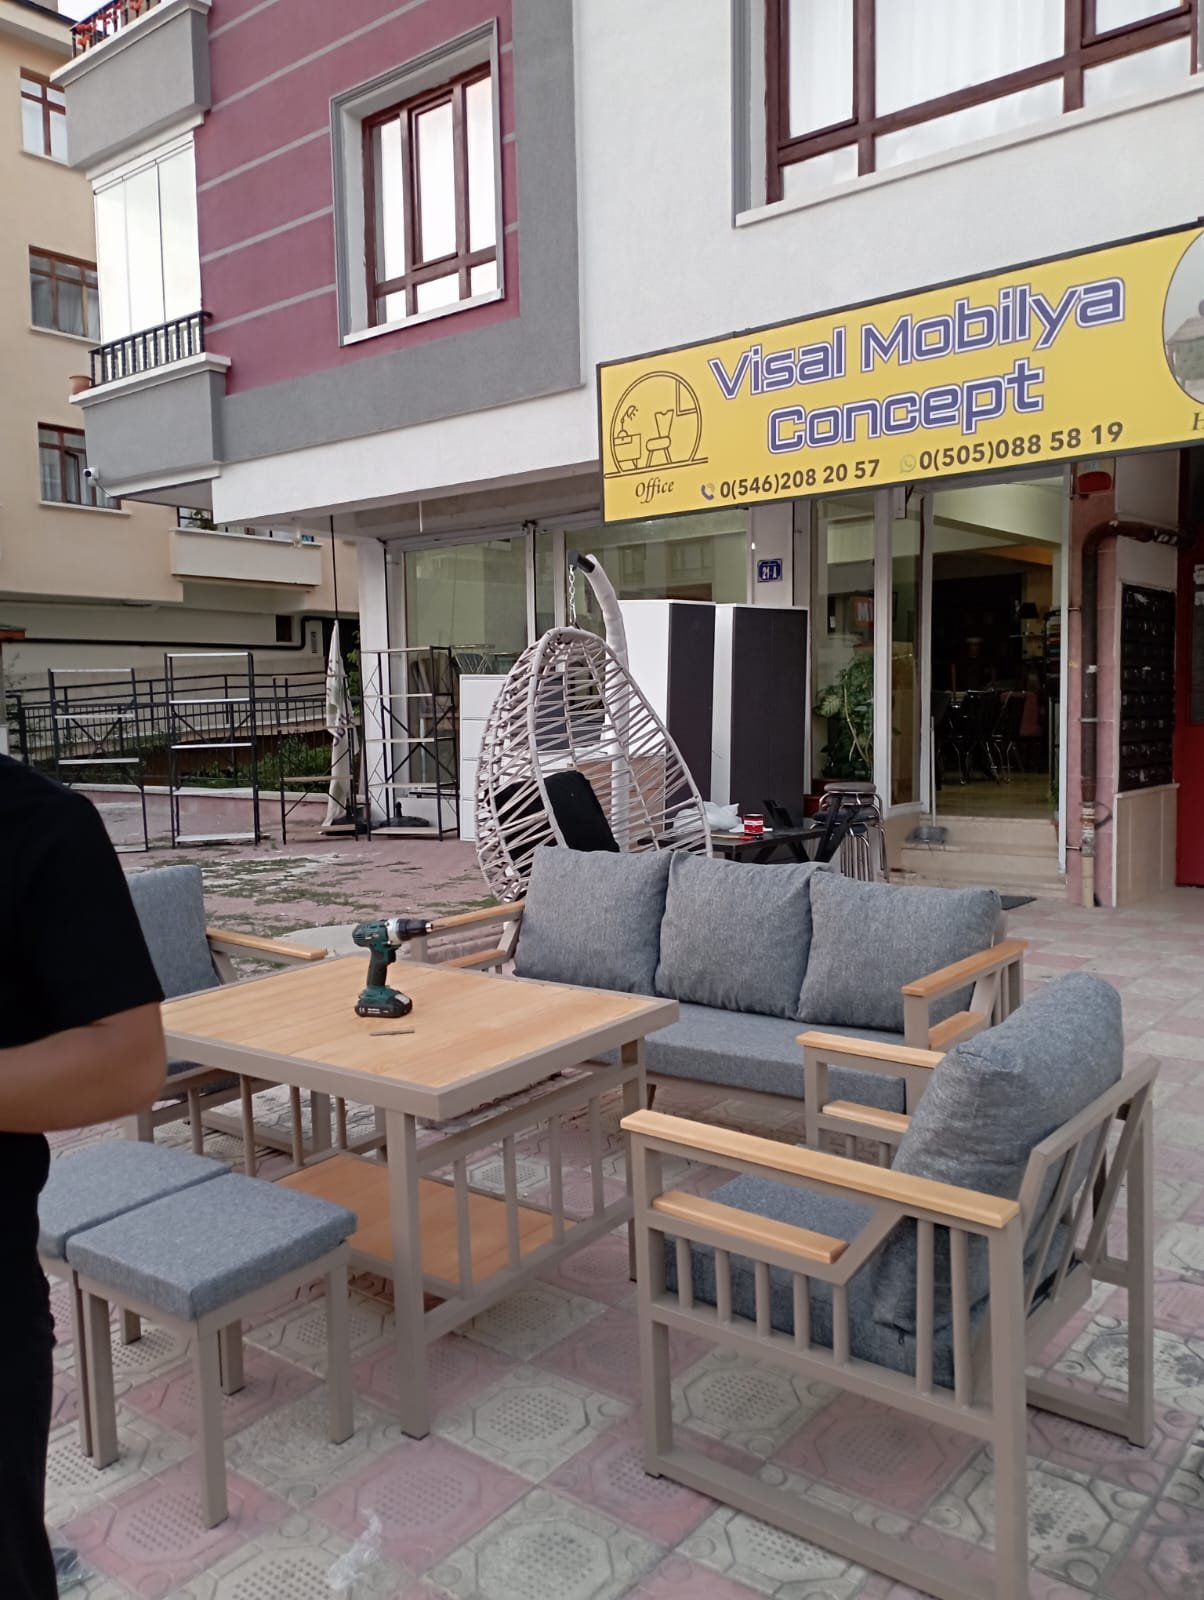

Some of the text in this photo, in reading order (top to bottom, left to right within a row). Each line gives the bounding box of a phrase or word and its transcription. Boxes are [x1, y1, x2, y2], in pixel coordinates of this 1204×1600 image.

[708, 277, 1125, 400] Visal Mobilya
[768, 358, 1044, 454] Concept
[919, 421, 1123, 471] 0(505)088 58 19
[635, 479, 674, 504] Office
[720, 459, 880, 499] 0(546)208 20 57
